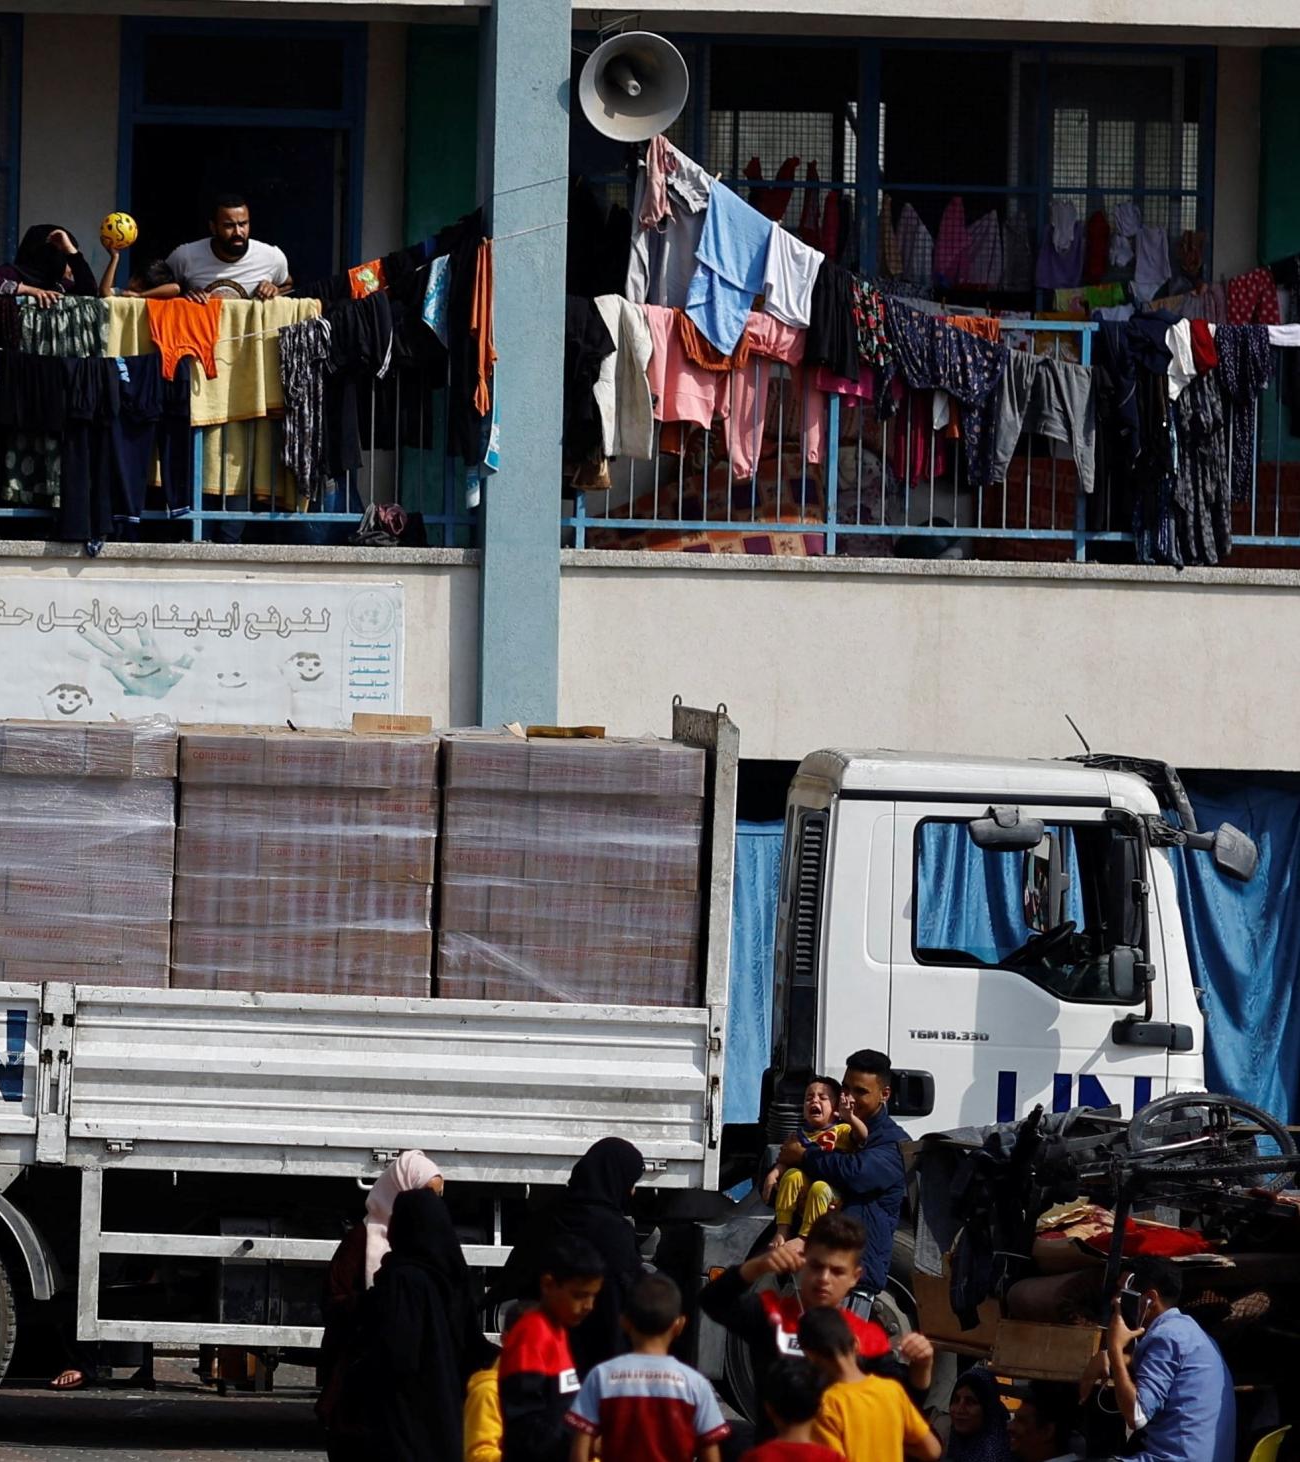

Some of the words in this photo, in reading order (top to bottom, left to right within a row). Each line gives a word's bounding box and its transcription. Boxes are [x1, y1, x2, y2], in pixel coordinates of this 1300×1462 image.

[36, 598, 100, 634] أجل
[104, 606, 147, 635] من
[152, 601, 240, 638] أيدينا
[244, 605, 331, 640] لنرفع
[349, 639, 391, 650] مدرسة
[192, 751, 228, 761] CORNED
[908, 1029, 938, 1039] TGM
[941, 1031, 989, 1041] 18.330
